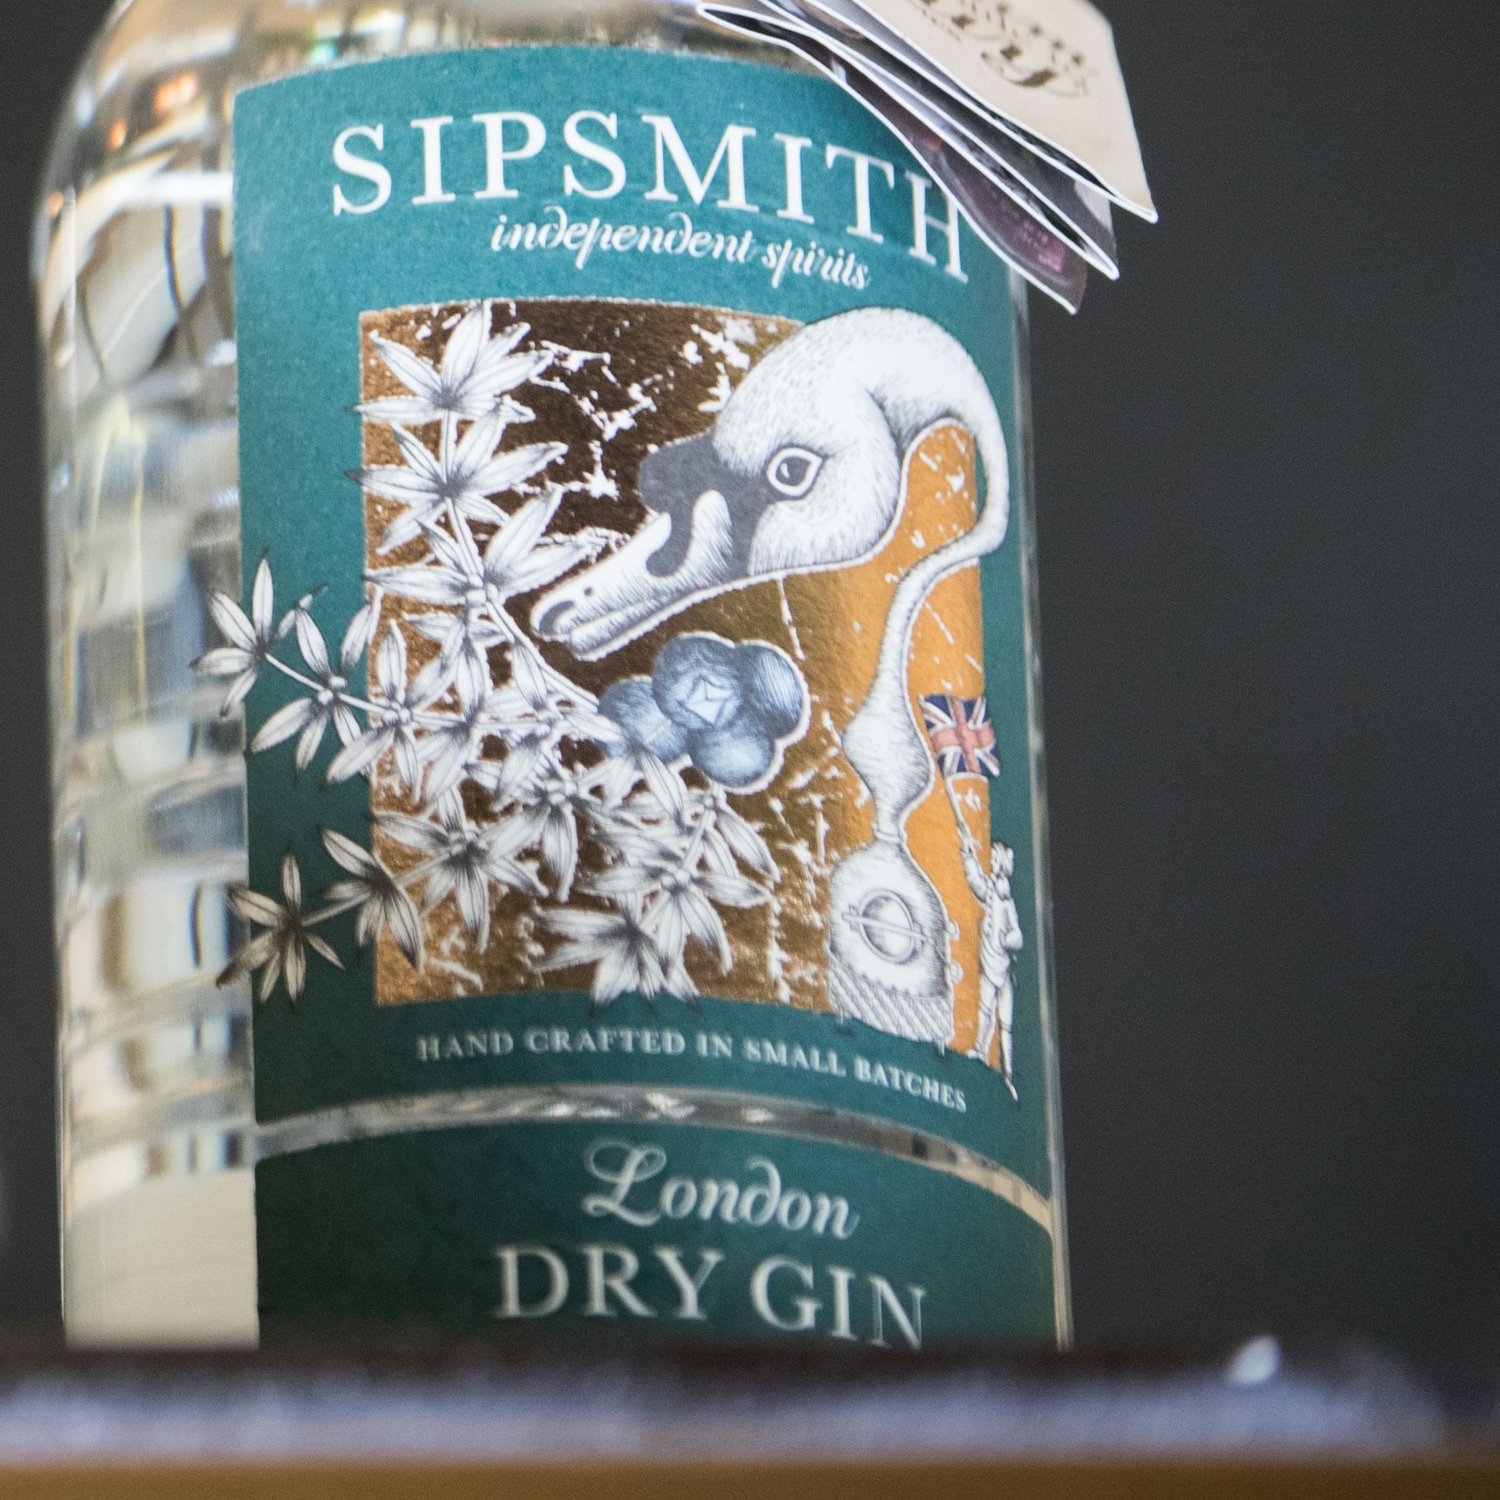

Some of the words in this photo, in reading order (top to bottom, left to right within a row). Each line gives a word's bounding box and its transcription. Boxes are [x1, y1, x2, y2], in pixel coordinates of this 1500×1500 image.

[331, 110, 969, 284] SIPSMITH
[491, 206, 753, 270] independent
[759, 228, 870, 290] spirits
[415, 1028, 514, 1063] HAND
[524, 1026, 687, 1057] CRAFTED
[696, 1031, 735, 1059] IN
[743, 1036, 848, 1079] SMALL
[855, 1054, 968, 1115] BATCHES
[580, 1139, 860, 1240] London
[495, 1245, 727, 1322] DRY
[751, 1254, 929, 1352] GIN
